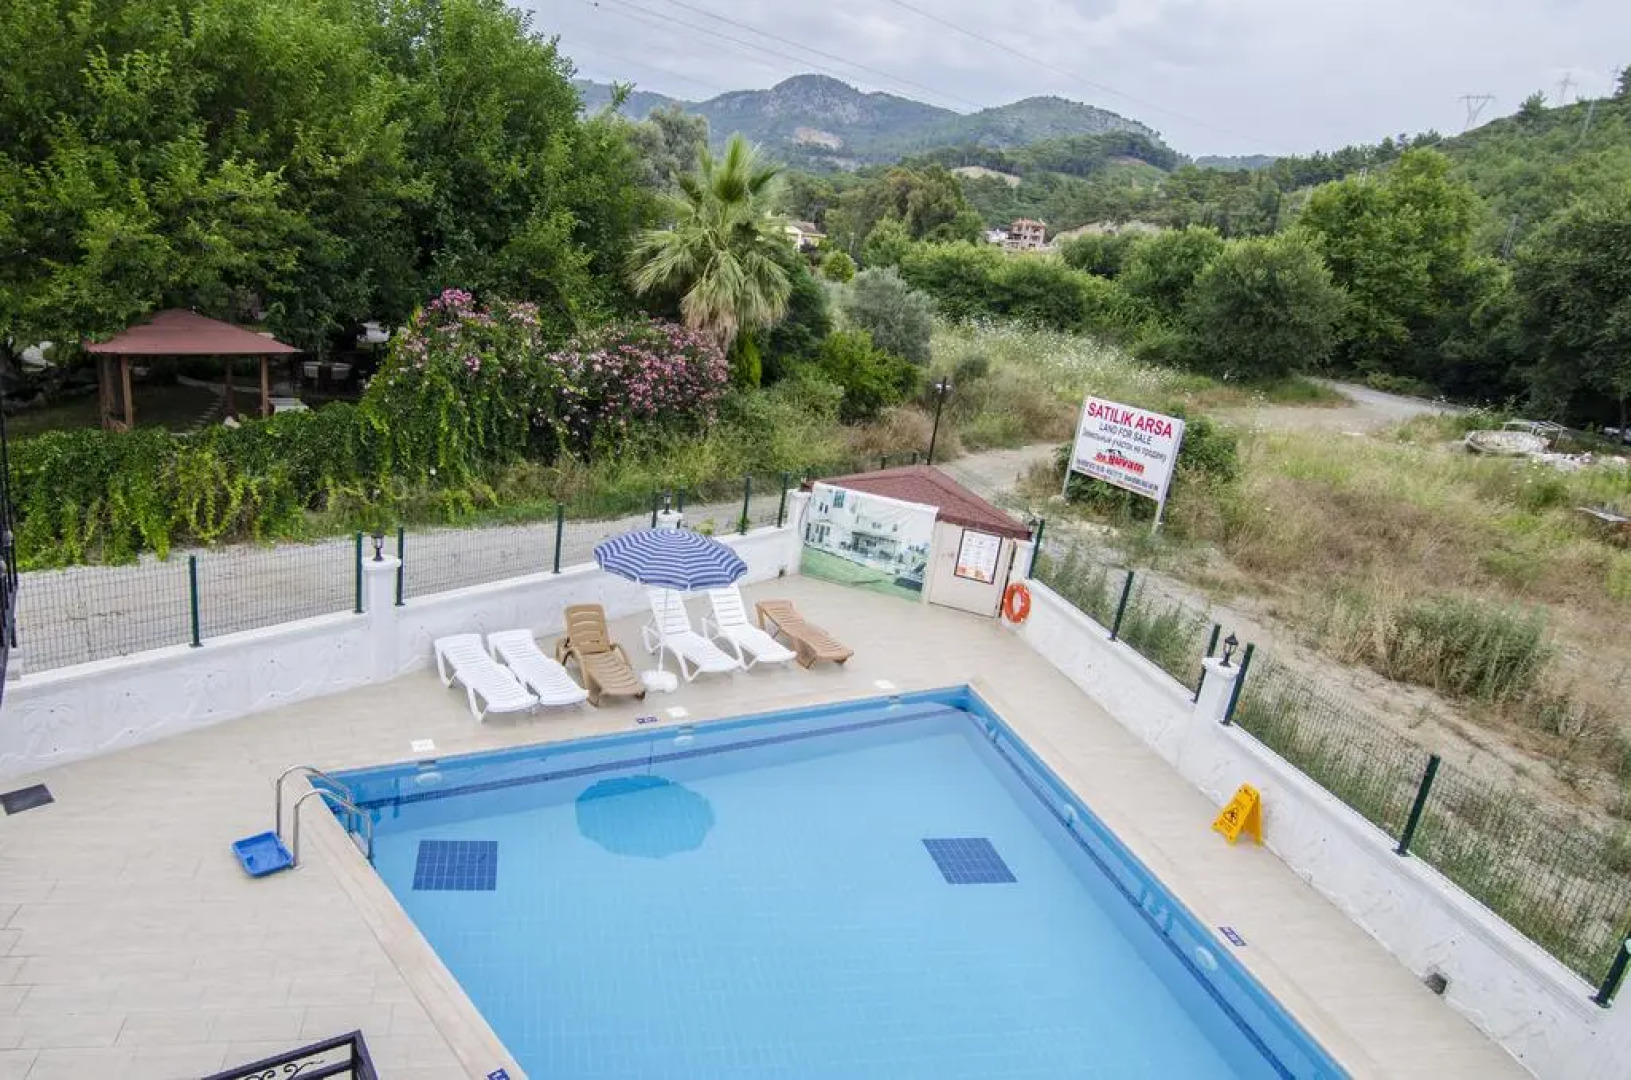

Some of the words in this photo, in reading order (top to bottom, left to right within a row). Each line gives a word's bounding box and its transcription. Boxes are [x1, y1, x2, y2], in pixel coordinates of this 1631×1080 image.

[1087, 402, 1135, 428] SATILIK
[1135, 416, 1172, 438] ARSA
[1099, 422, 1117, 435] LAND
[1118, 427, 1132, 439] FOR
[1133, 432, 1153, 445] SALE
